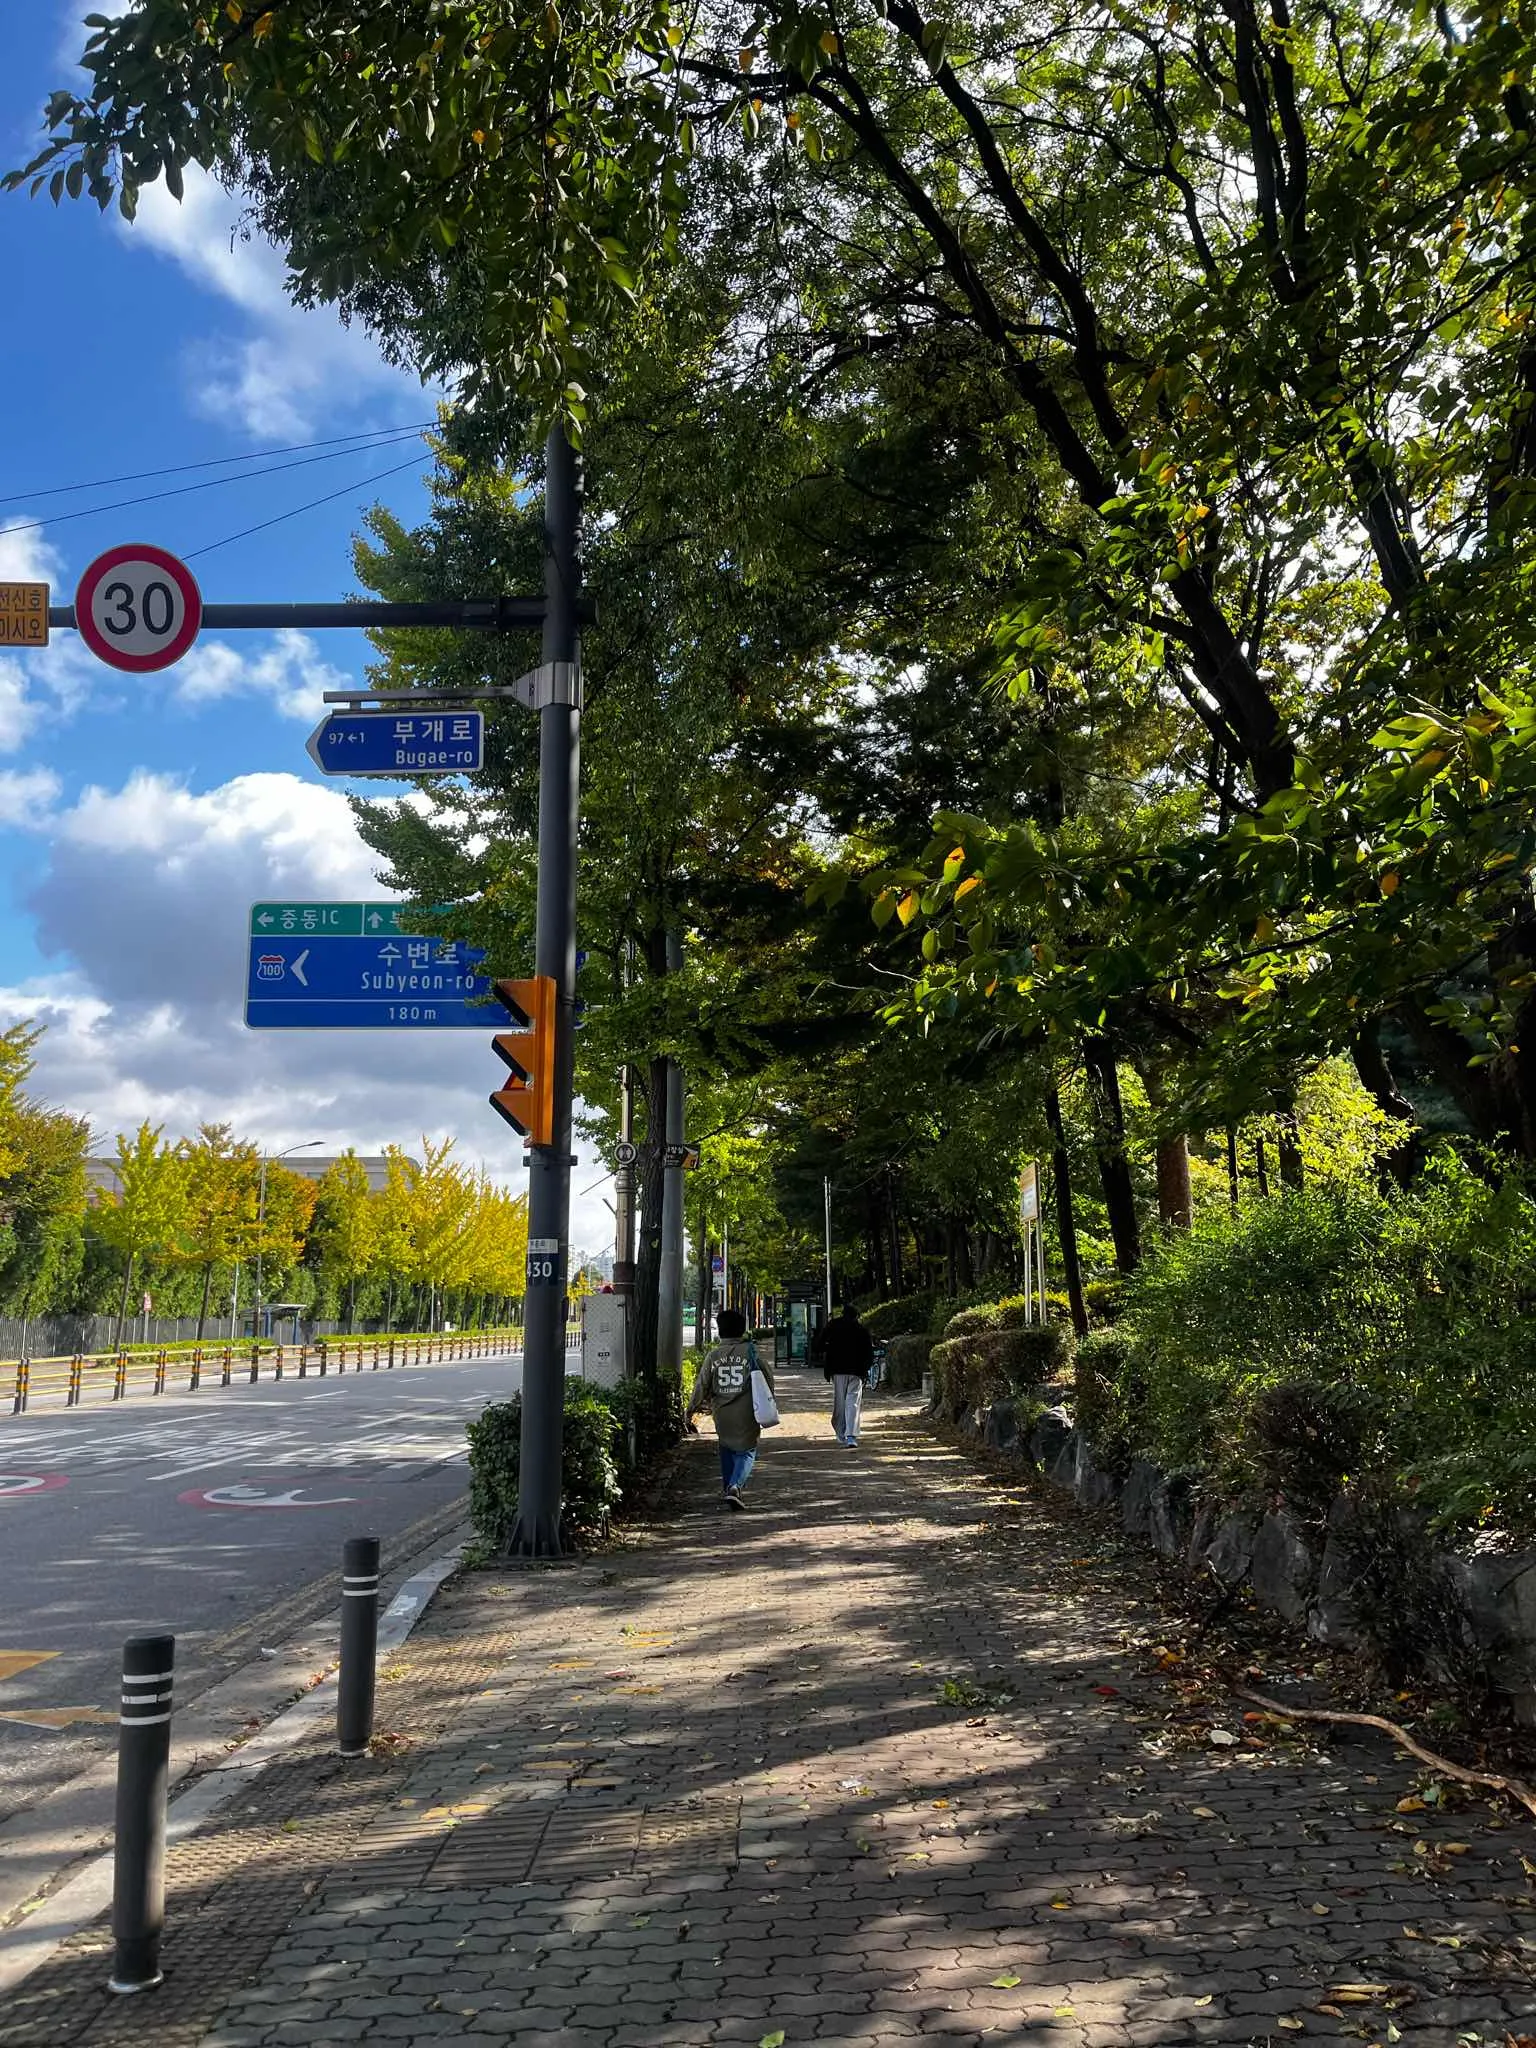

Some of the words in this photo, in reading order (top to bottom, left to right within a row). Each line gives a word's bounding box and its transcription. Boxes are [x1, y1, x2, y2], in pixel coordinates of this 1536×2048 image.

[104, 581, 174, 636] 30
[393, 719, 473, 744] 부개로
[395, 750, 473, 767] Bugae-ro
[280, 909, 340, 930] 중동IC
[377, 942, 460, 969] 수변로
[263, 964, 281, 976] 100
[361, 971, 475, 993] Subyeon-ro
[718, 1365, 744, 1386] 55
